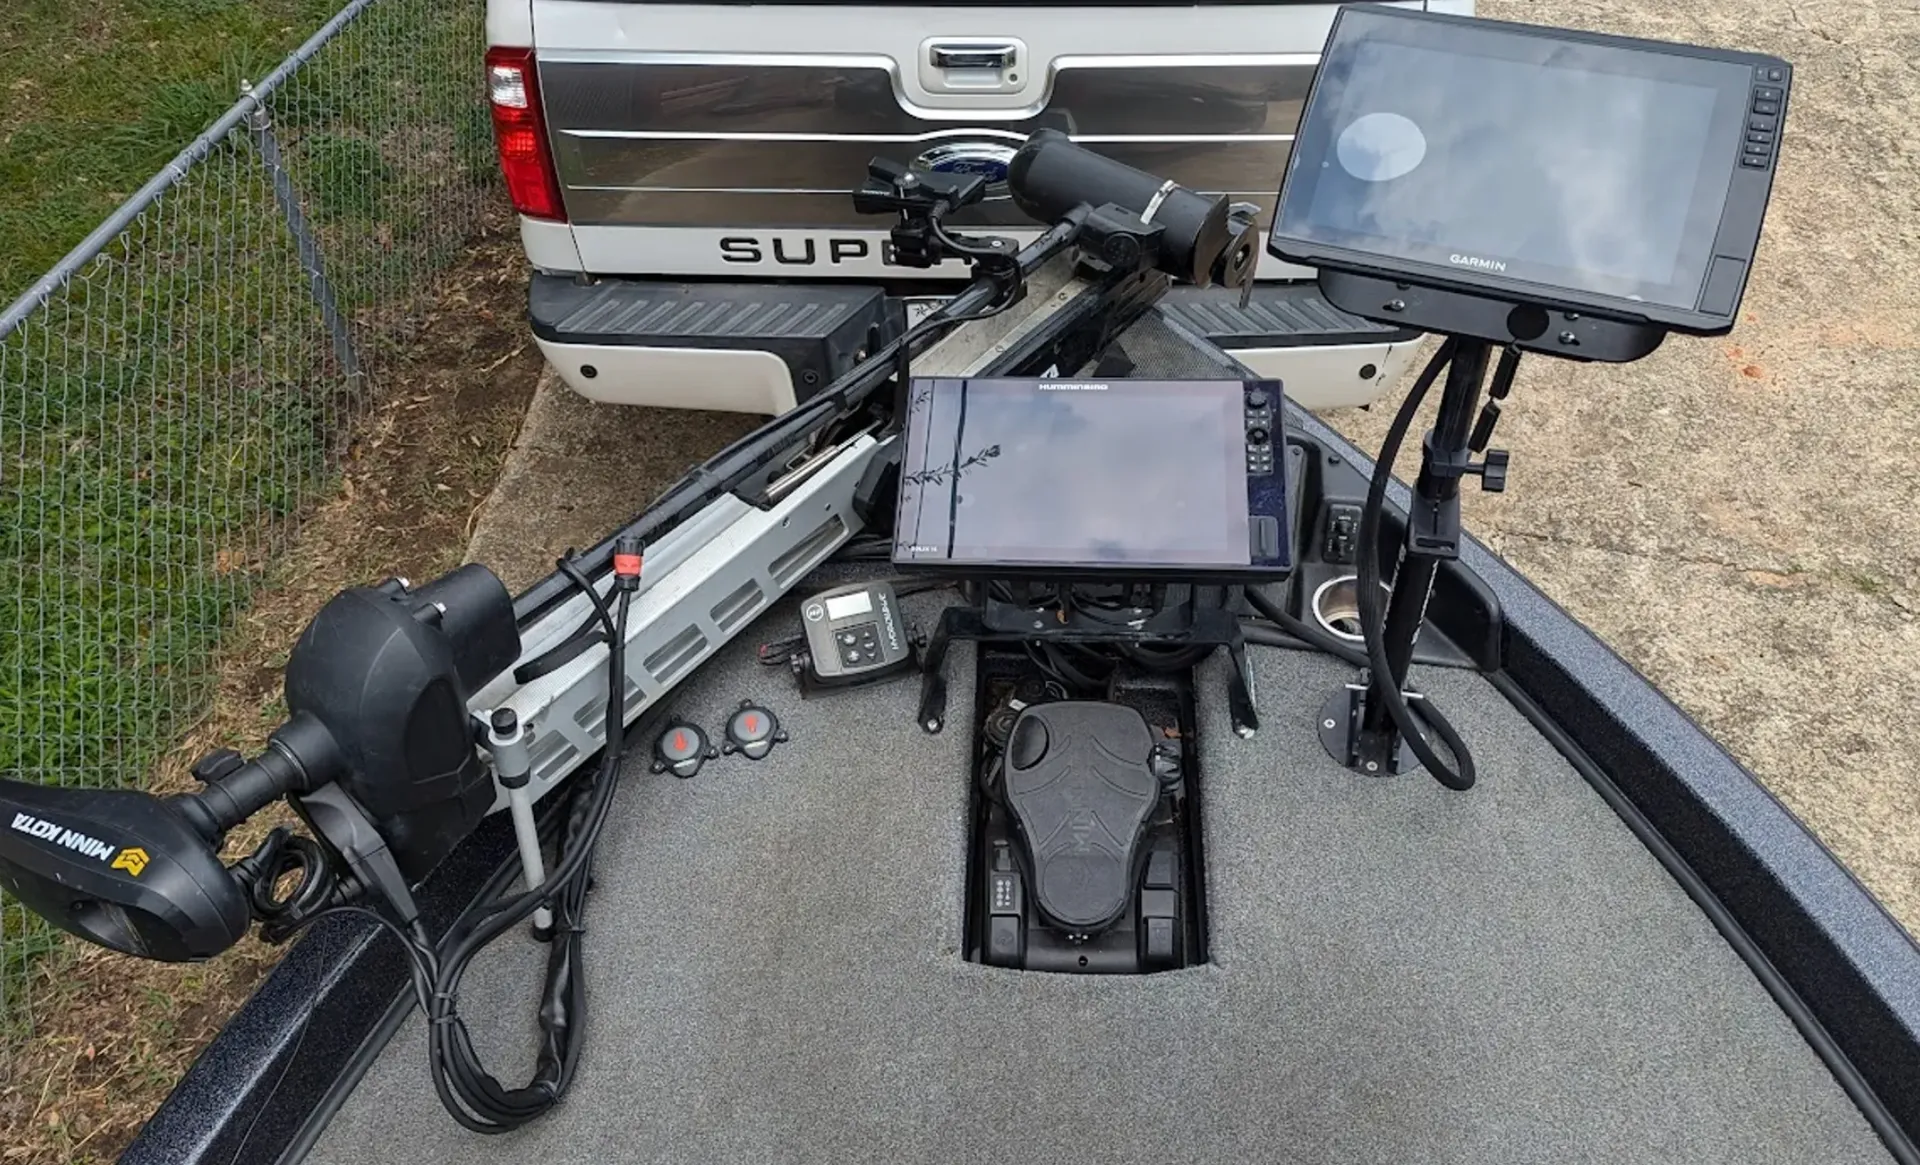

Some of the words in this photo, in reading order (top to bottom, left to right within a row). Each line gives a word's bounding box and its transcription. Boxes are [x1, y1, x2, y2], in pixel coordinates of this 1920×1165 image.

[1449, 253, 1507, 272] GARMIN
[1038, 383, 1109, 391] HUMMINBIRD
[10, 811, 63, 842] KOTA
[56, 828, 116, 862] MINN
